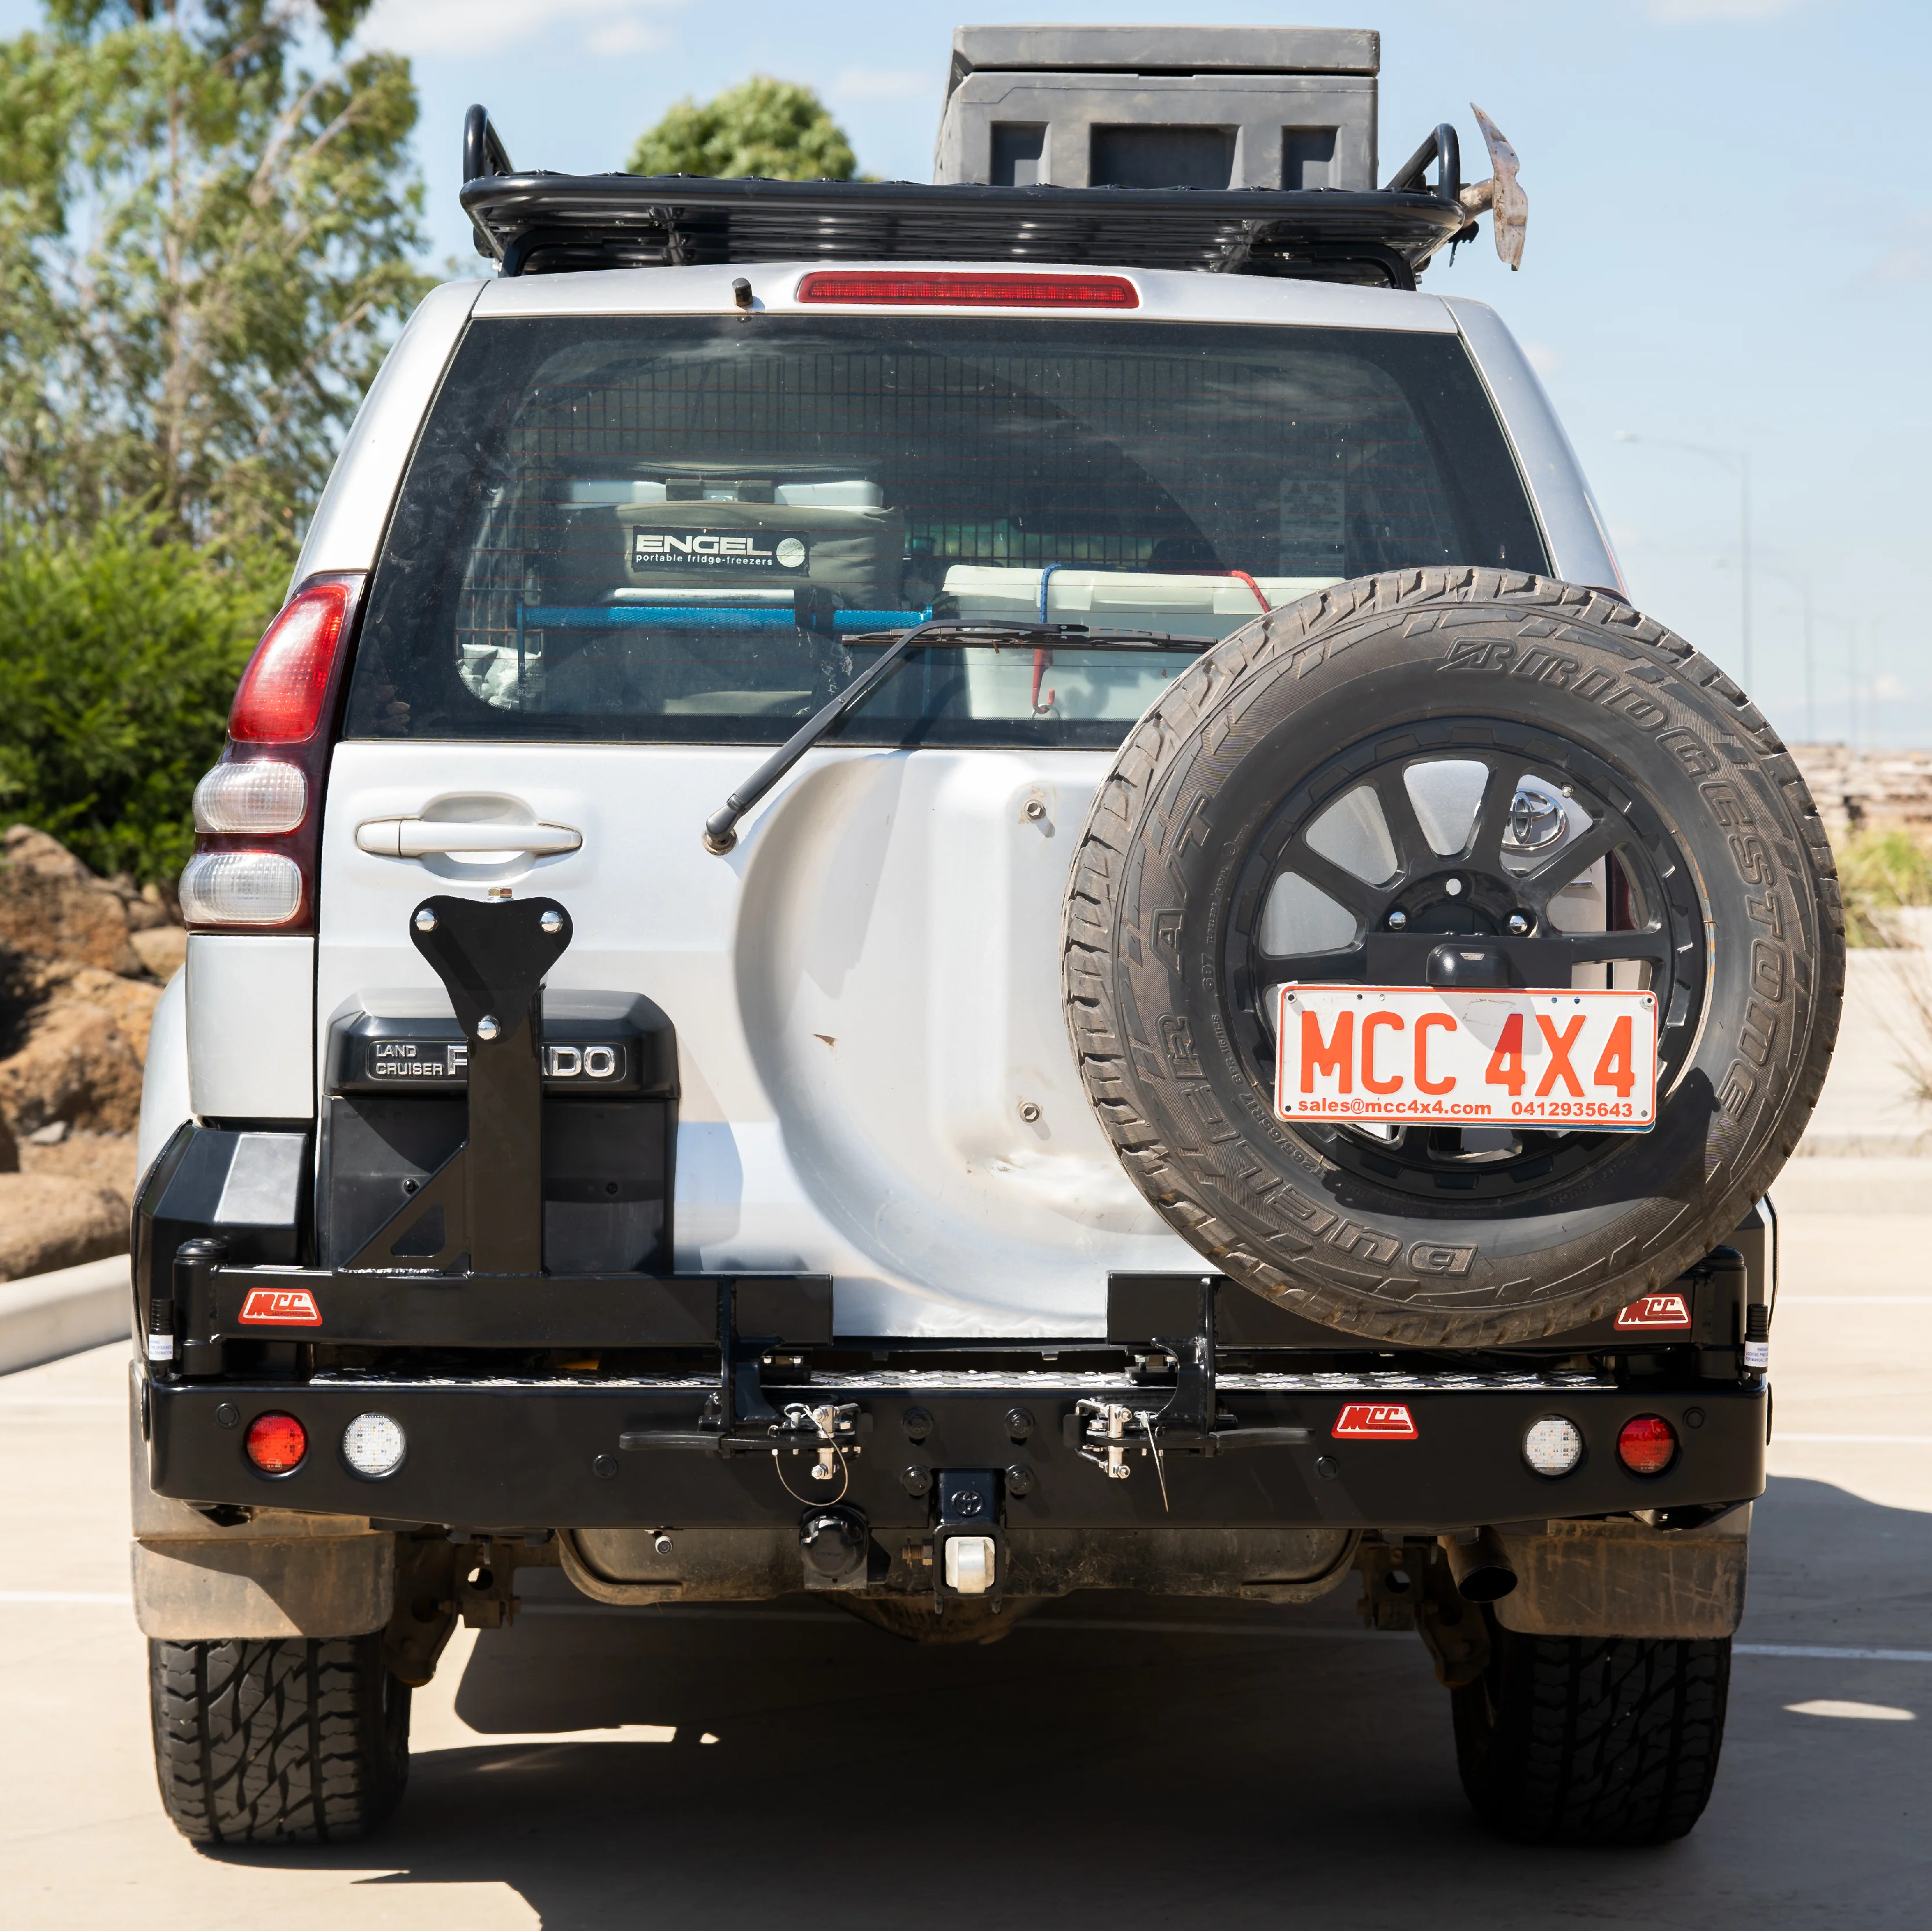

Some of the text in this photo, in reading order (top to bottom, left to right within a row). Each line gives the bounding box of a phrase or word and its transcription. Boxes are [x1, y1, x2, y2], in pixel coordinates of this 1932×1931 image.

[636, 535, 772, 555] ENGEL
[636, 554, 683, 563] portable
[688, 554, 773, 565] fridge-freezers
[1437, 636, 1786, 1124] BRIDGESTONE
[1201, 953, 1215, 992] 697
[376, 1045, 418, 1058] LAND
[1299, 1010, 1635, 1098] MCC 4X4
[375, 1062, 443, 1076] CRUISER
[1298, 1098, 1633, 1118] sales@mcc4x4.com 0412935643
[1159, 1012, 1478, 1278] DUELER
[245, 1293, 312, 1316] MCC
[1620, 1299, 1683, 1322] MCC
[1339, 1407, 1408, 1429] MCC
